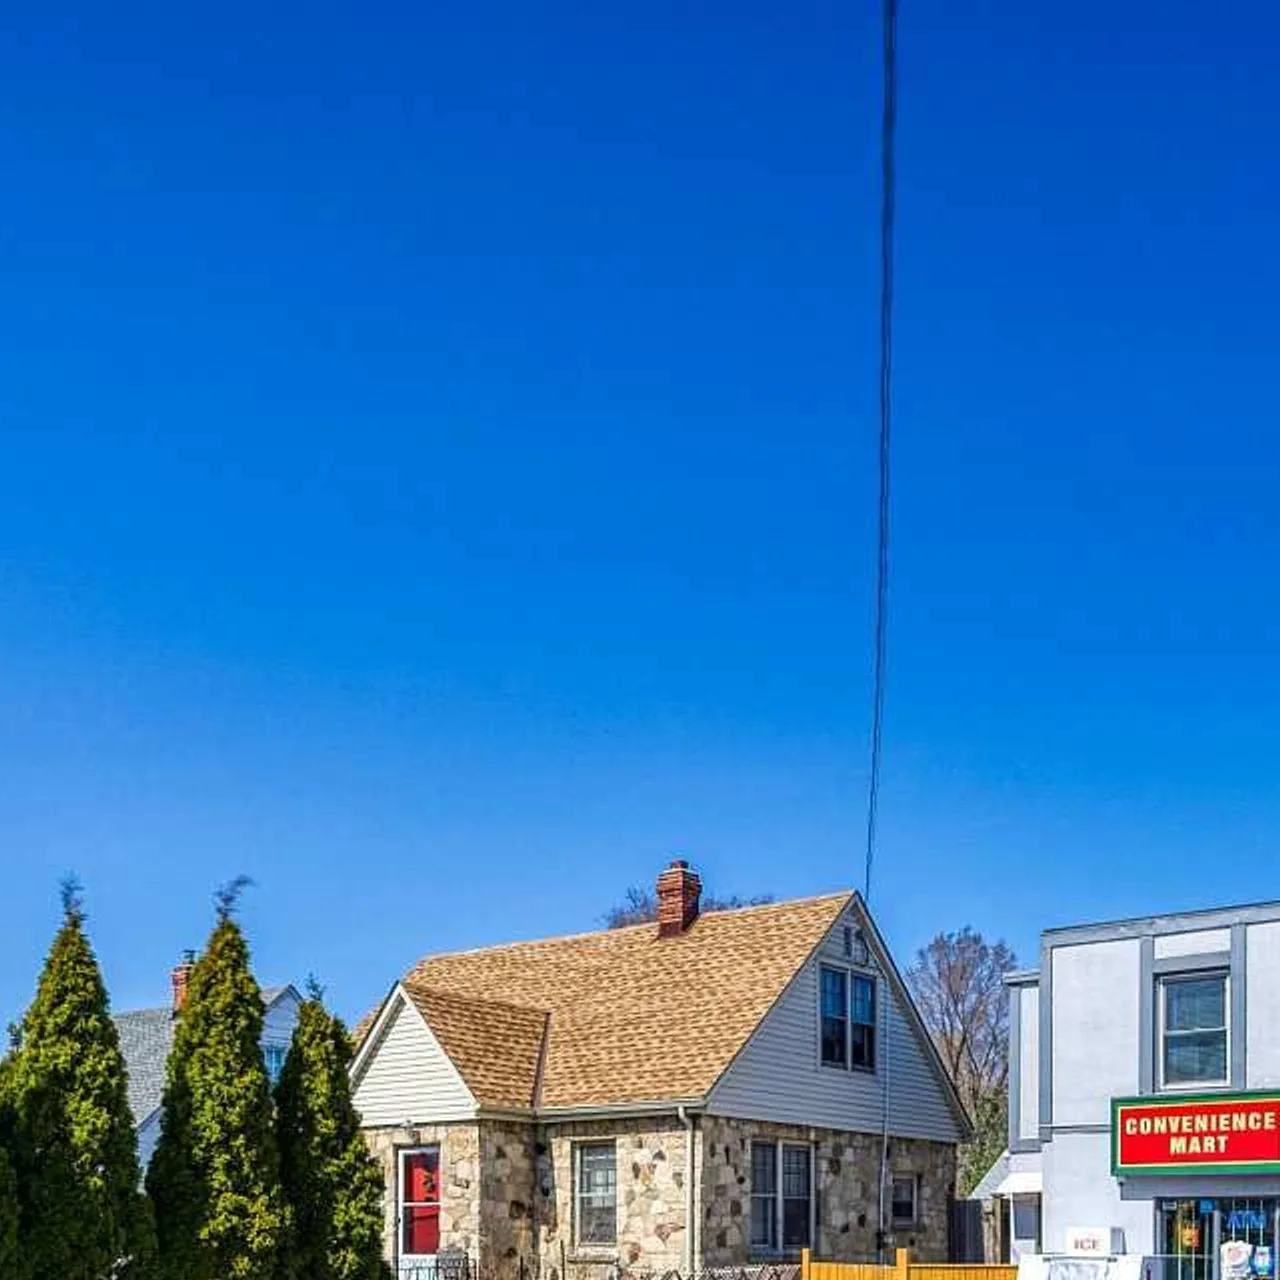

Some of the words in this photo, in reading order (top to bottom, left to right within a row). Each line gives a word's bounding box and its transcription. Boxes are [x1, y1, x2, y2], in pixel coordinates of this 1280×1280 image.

[1125, 1111, 1276, 1135] CONVENIENCE
[1169, 1135, 1229, 1156] MART
[1227, 1210, 1266, 1229] ATM
[1074, 1238, 1100, 1250] ICE
